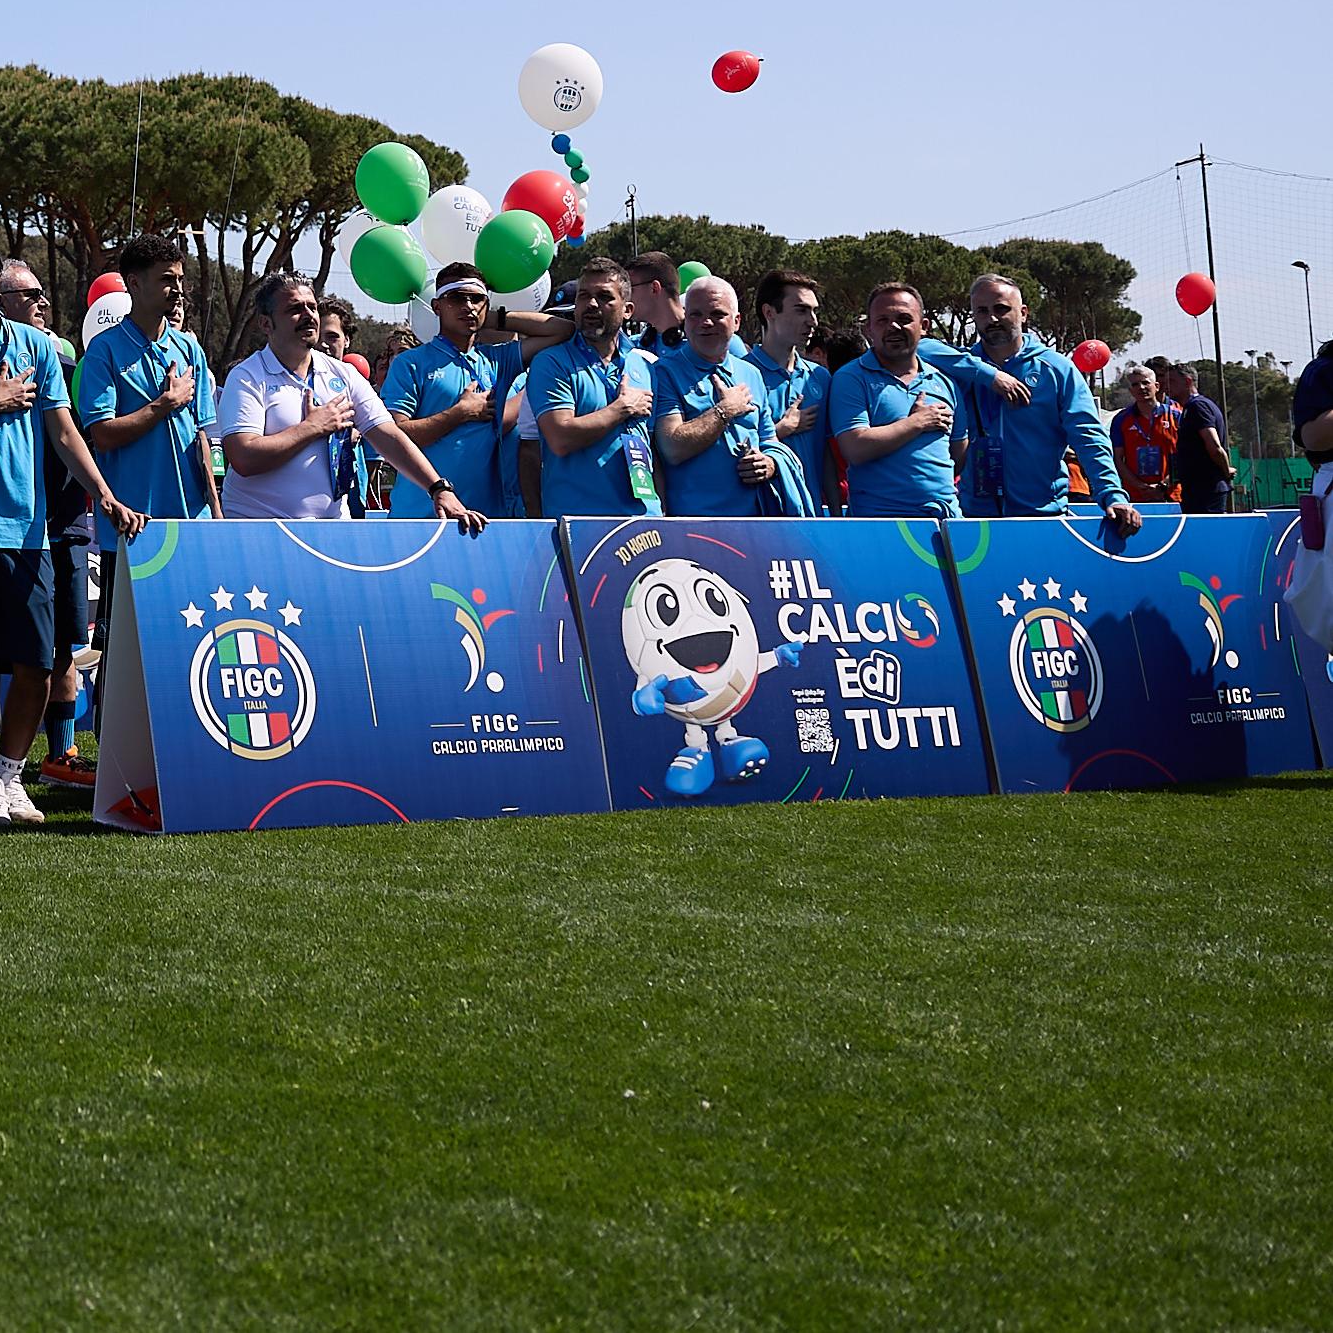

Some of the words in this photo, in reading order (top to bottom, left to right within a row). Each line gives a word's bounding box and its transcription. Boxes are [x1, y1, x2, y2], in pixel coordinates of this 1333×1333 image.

[466, 223, 483, 233] TUT
[97, 316, 123, 324] CALC
[626, 529, 662, 557] KIAMO
[768, 559, 833, 599] #IL
[1031, 650, 1079, 679] FIGC
[220, 667, 284, 699] FIGC
[1051, 680, 1069, 688] ITALIA
[1217, 687, 1252, 704] FIGC
[243, 700, 268, 710] ITALIA
[471, 714, 520, 733] FIGC
[1190, 710, 1223, 724] CALCIO
[1226, 706, 1286, 722] PARALIMPICO
[844, 705, 962, 751] TUTTI
[432, 739, 477, 755] CALCIO
[481, 737, 565, 753] PARALIMPICO
